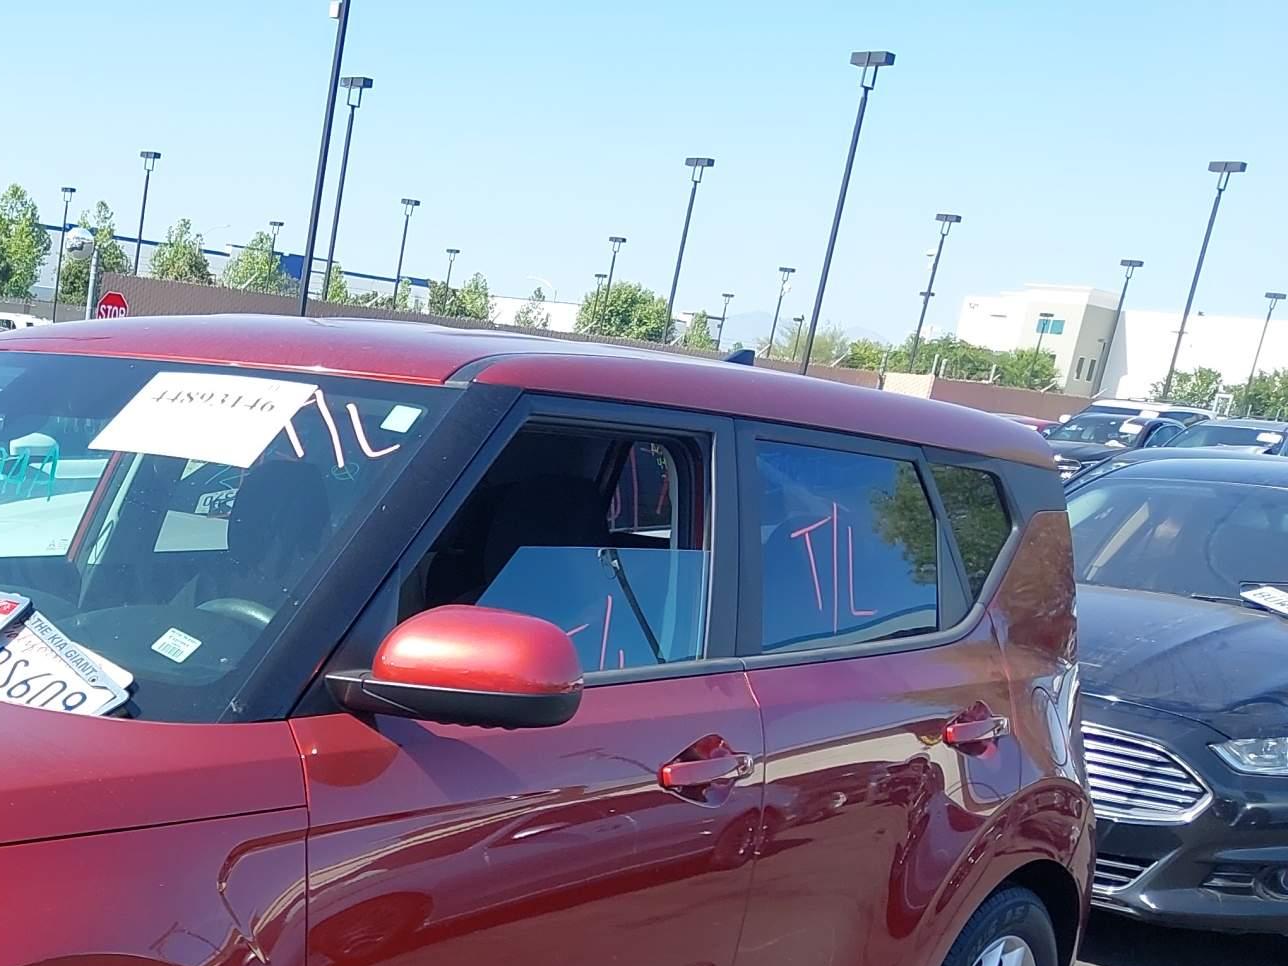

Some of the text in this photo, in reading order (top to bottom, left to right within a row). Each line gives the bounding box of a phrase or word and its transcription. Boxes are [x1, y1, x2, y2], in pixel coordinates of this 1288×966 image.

[98, 304, 126, 320] STOP
[152, 389, 275, 412] 44893146
[30, 617, 48, 637] THE
[47, 632, 67, 652] KIA
[64, 646, 97, 681] GIANT
